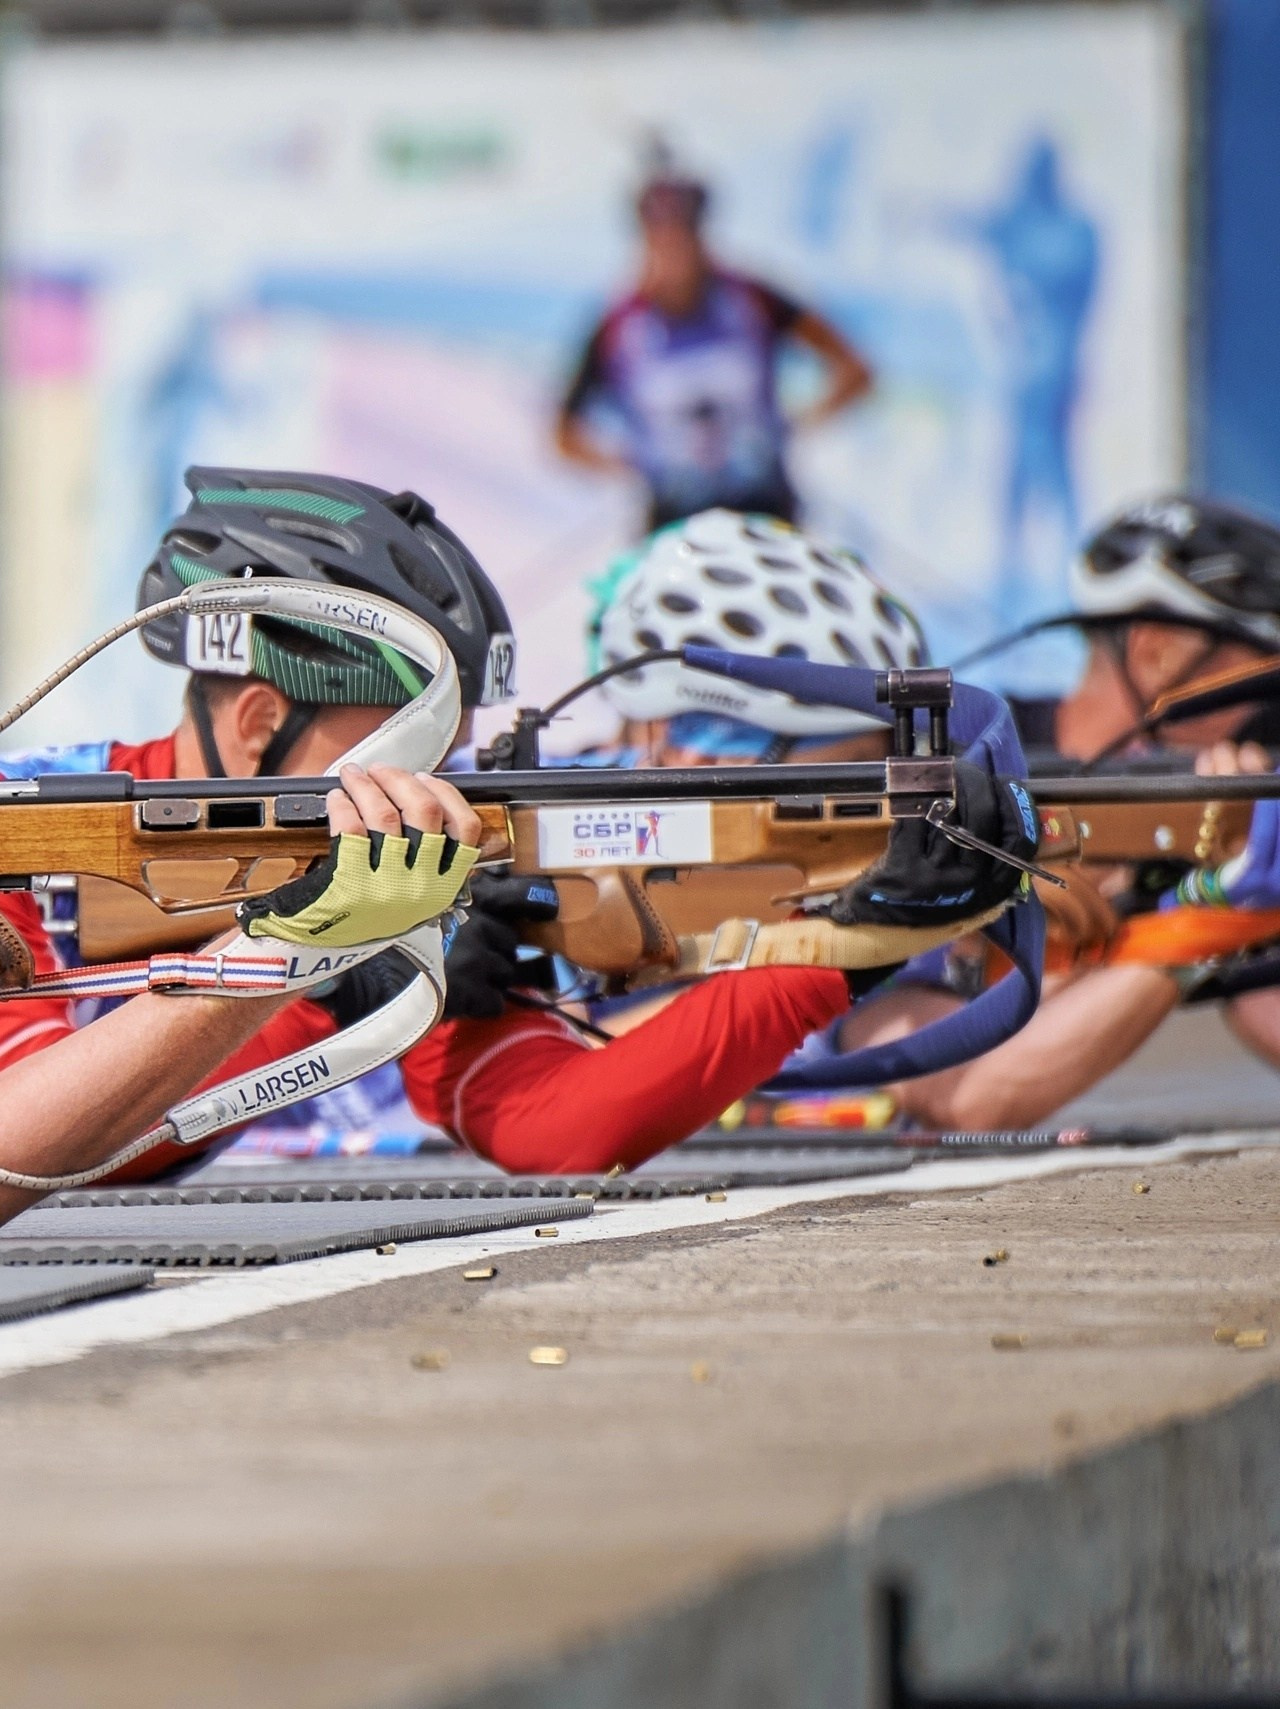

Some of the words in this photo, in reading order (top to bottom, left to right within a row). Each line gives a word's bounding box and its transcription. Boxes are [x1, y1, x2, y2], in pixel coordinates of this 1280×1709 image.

[198, 613, 244, 661] 142
[489, 643, 518, 697] 142
[573, 822, 631, 839] СБР
[574, 848, 595, 858] 30
[288, 950, 369, 980] LAR
[239, 1055, 330, 1111] LARSEN
